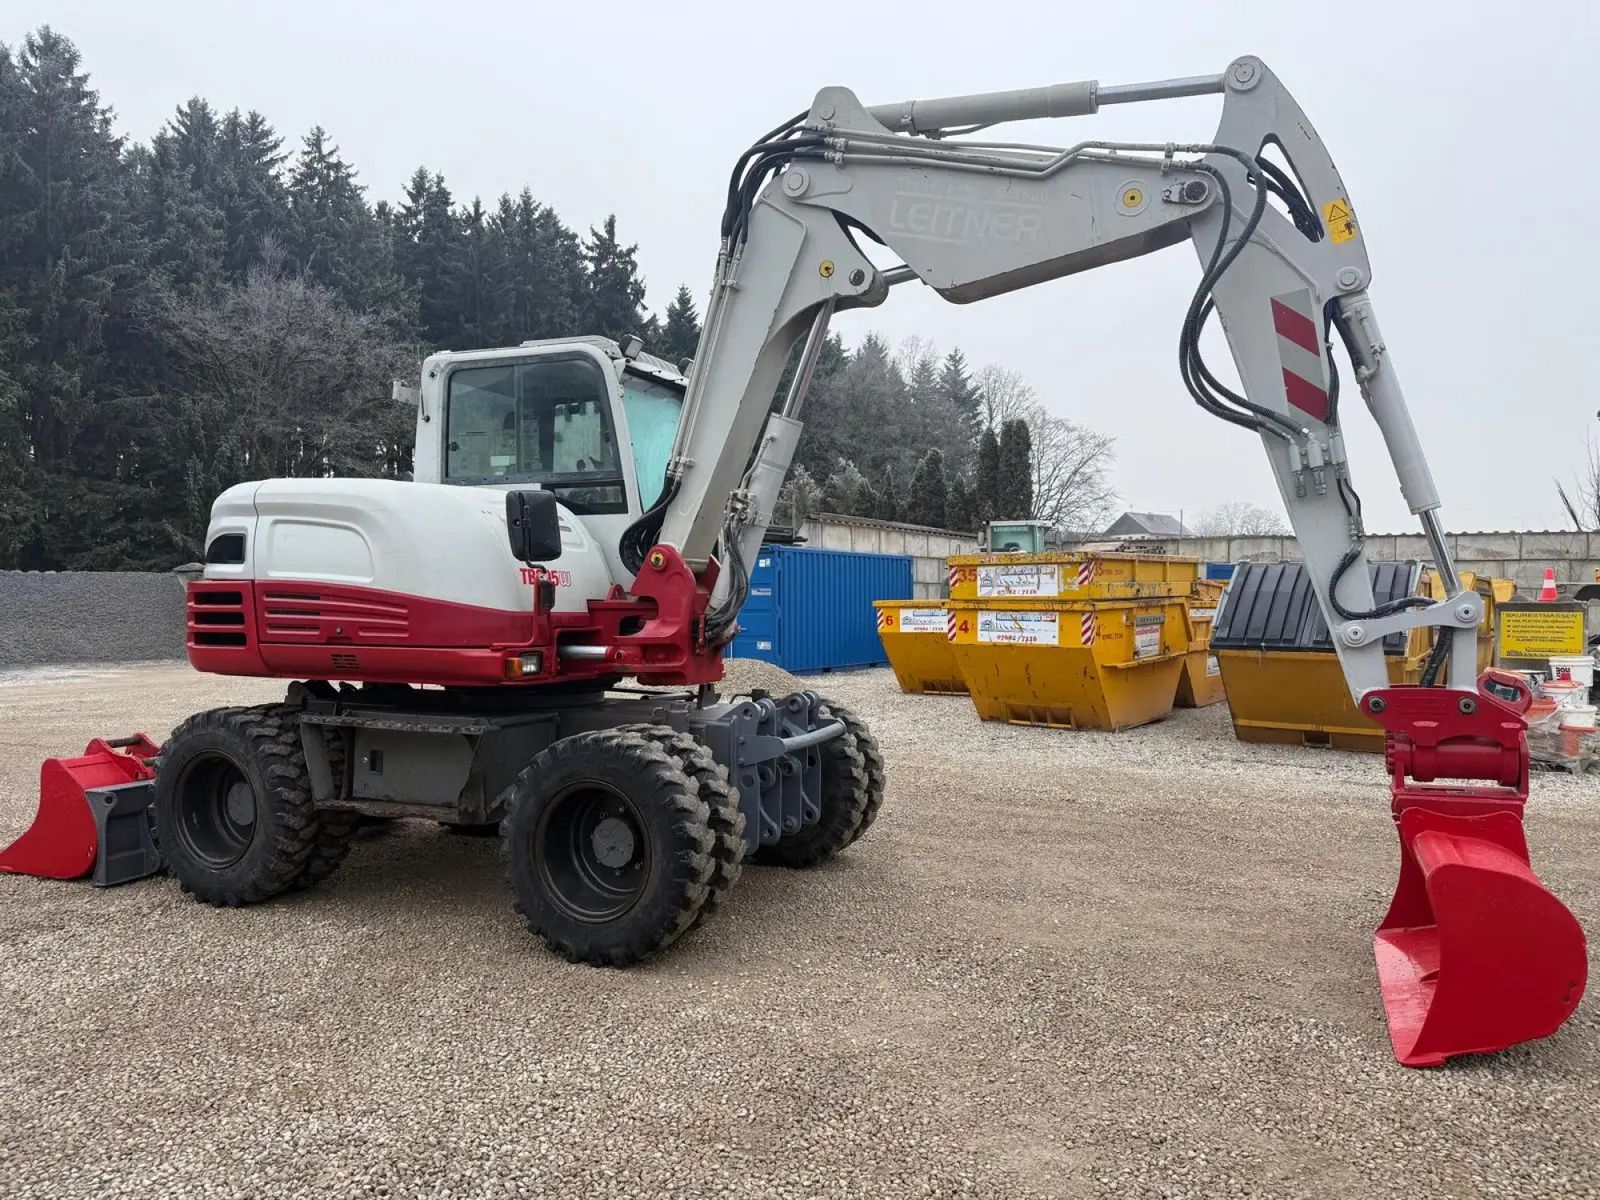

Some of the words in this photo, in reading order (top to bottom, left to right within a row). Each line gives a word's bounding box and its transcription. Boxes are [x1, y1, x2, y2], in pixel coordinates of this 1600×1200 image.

[889, 200, 1042, 241] LEITNER
[958, 569, 977, 583] 35
[886, 615, 893, 626] 6
[958, 619, 969, 633] 4
